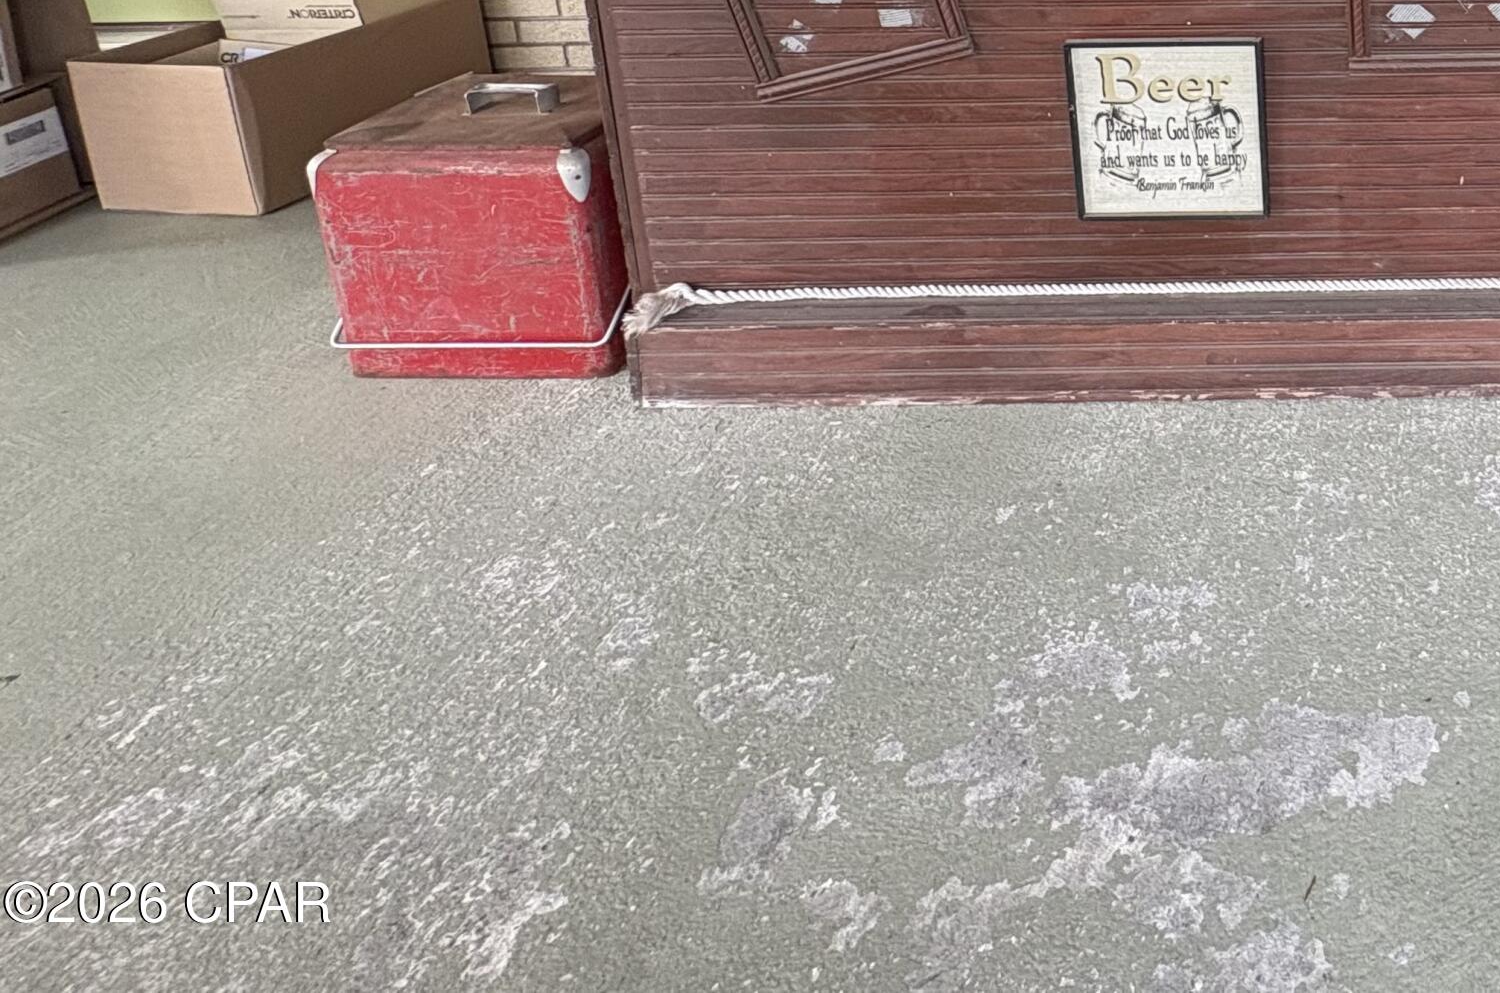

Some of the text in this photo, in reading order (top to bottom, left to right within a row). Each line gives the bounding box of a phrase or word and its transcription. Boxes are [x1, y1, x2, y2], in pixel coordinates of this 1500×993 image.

[1095, 52, 1232, 104] Beer
[1105, 116, 1237, 146] Proof that God loves us
[1100, 143, 1248, 172] and wants us to be happy
